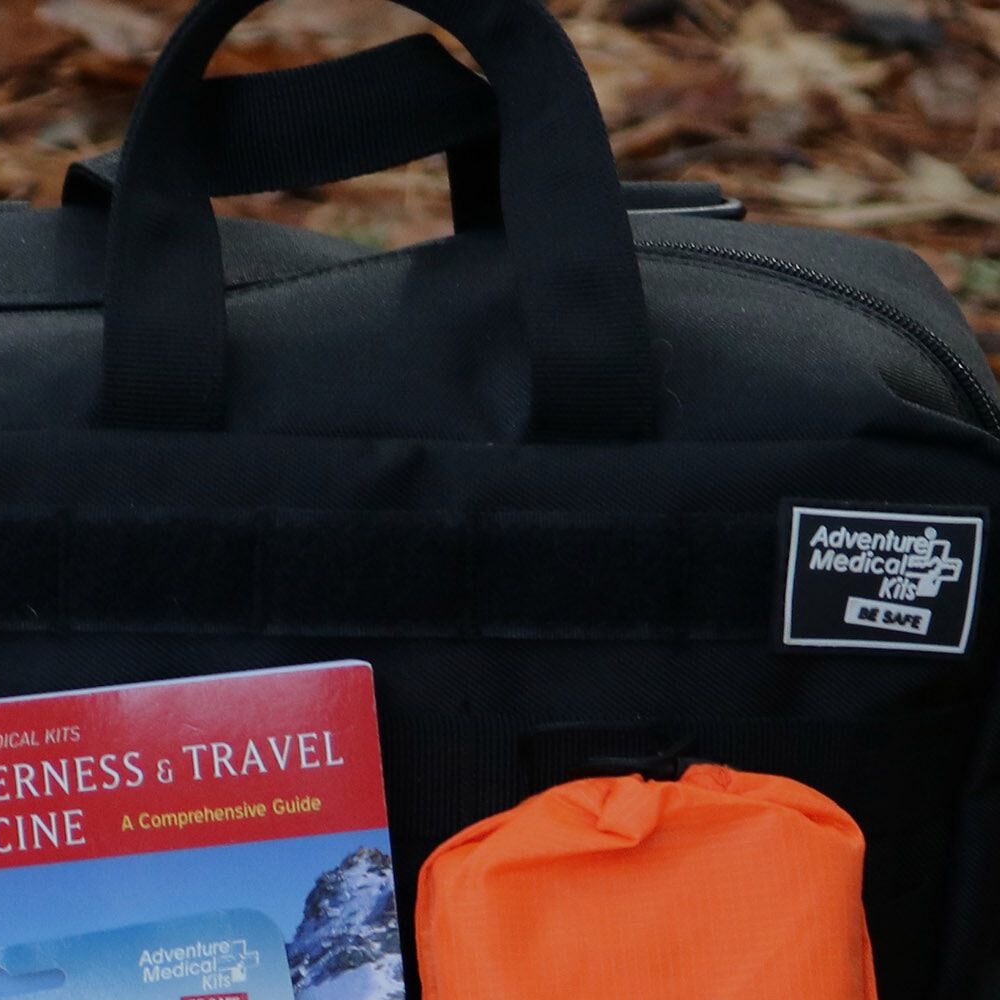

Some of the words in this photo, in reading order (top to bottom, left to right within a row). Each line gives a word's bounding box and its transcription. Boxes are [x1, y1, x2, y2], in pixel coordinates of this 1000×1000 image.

[810, 525, 931, 554] Adventure
[809, 549, 907, 575] Medical
[878, 577, 917, 601] Kits
[858, 606, 877, 622] BE
[882, 609, 922, 629] SAFE
[45, 726, 81, 744] KITS
[156, 758, 174, 784] &
[182, 730, 344, 781] TRAVEL
[121, 815, 134, 831] A
[138, 802, 267, 830] Comprehensive
[272, 796, 322, 815] Guide
[139, 940, 231, 967] Adventure
[142, 957, 217, 983] Medical
[202, 973, 232, 991] Kits
